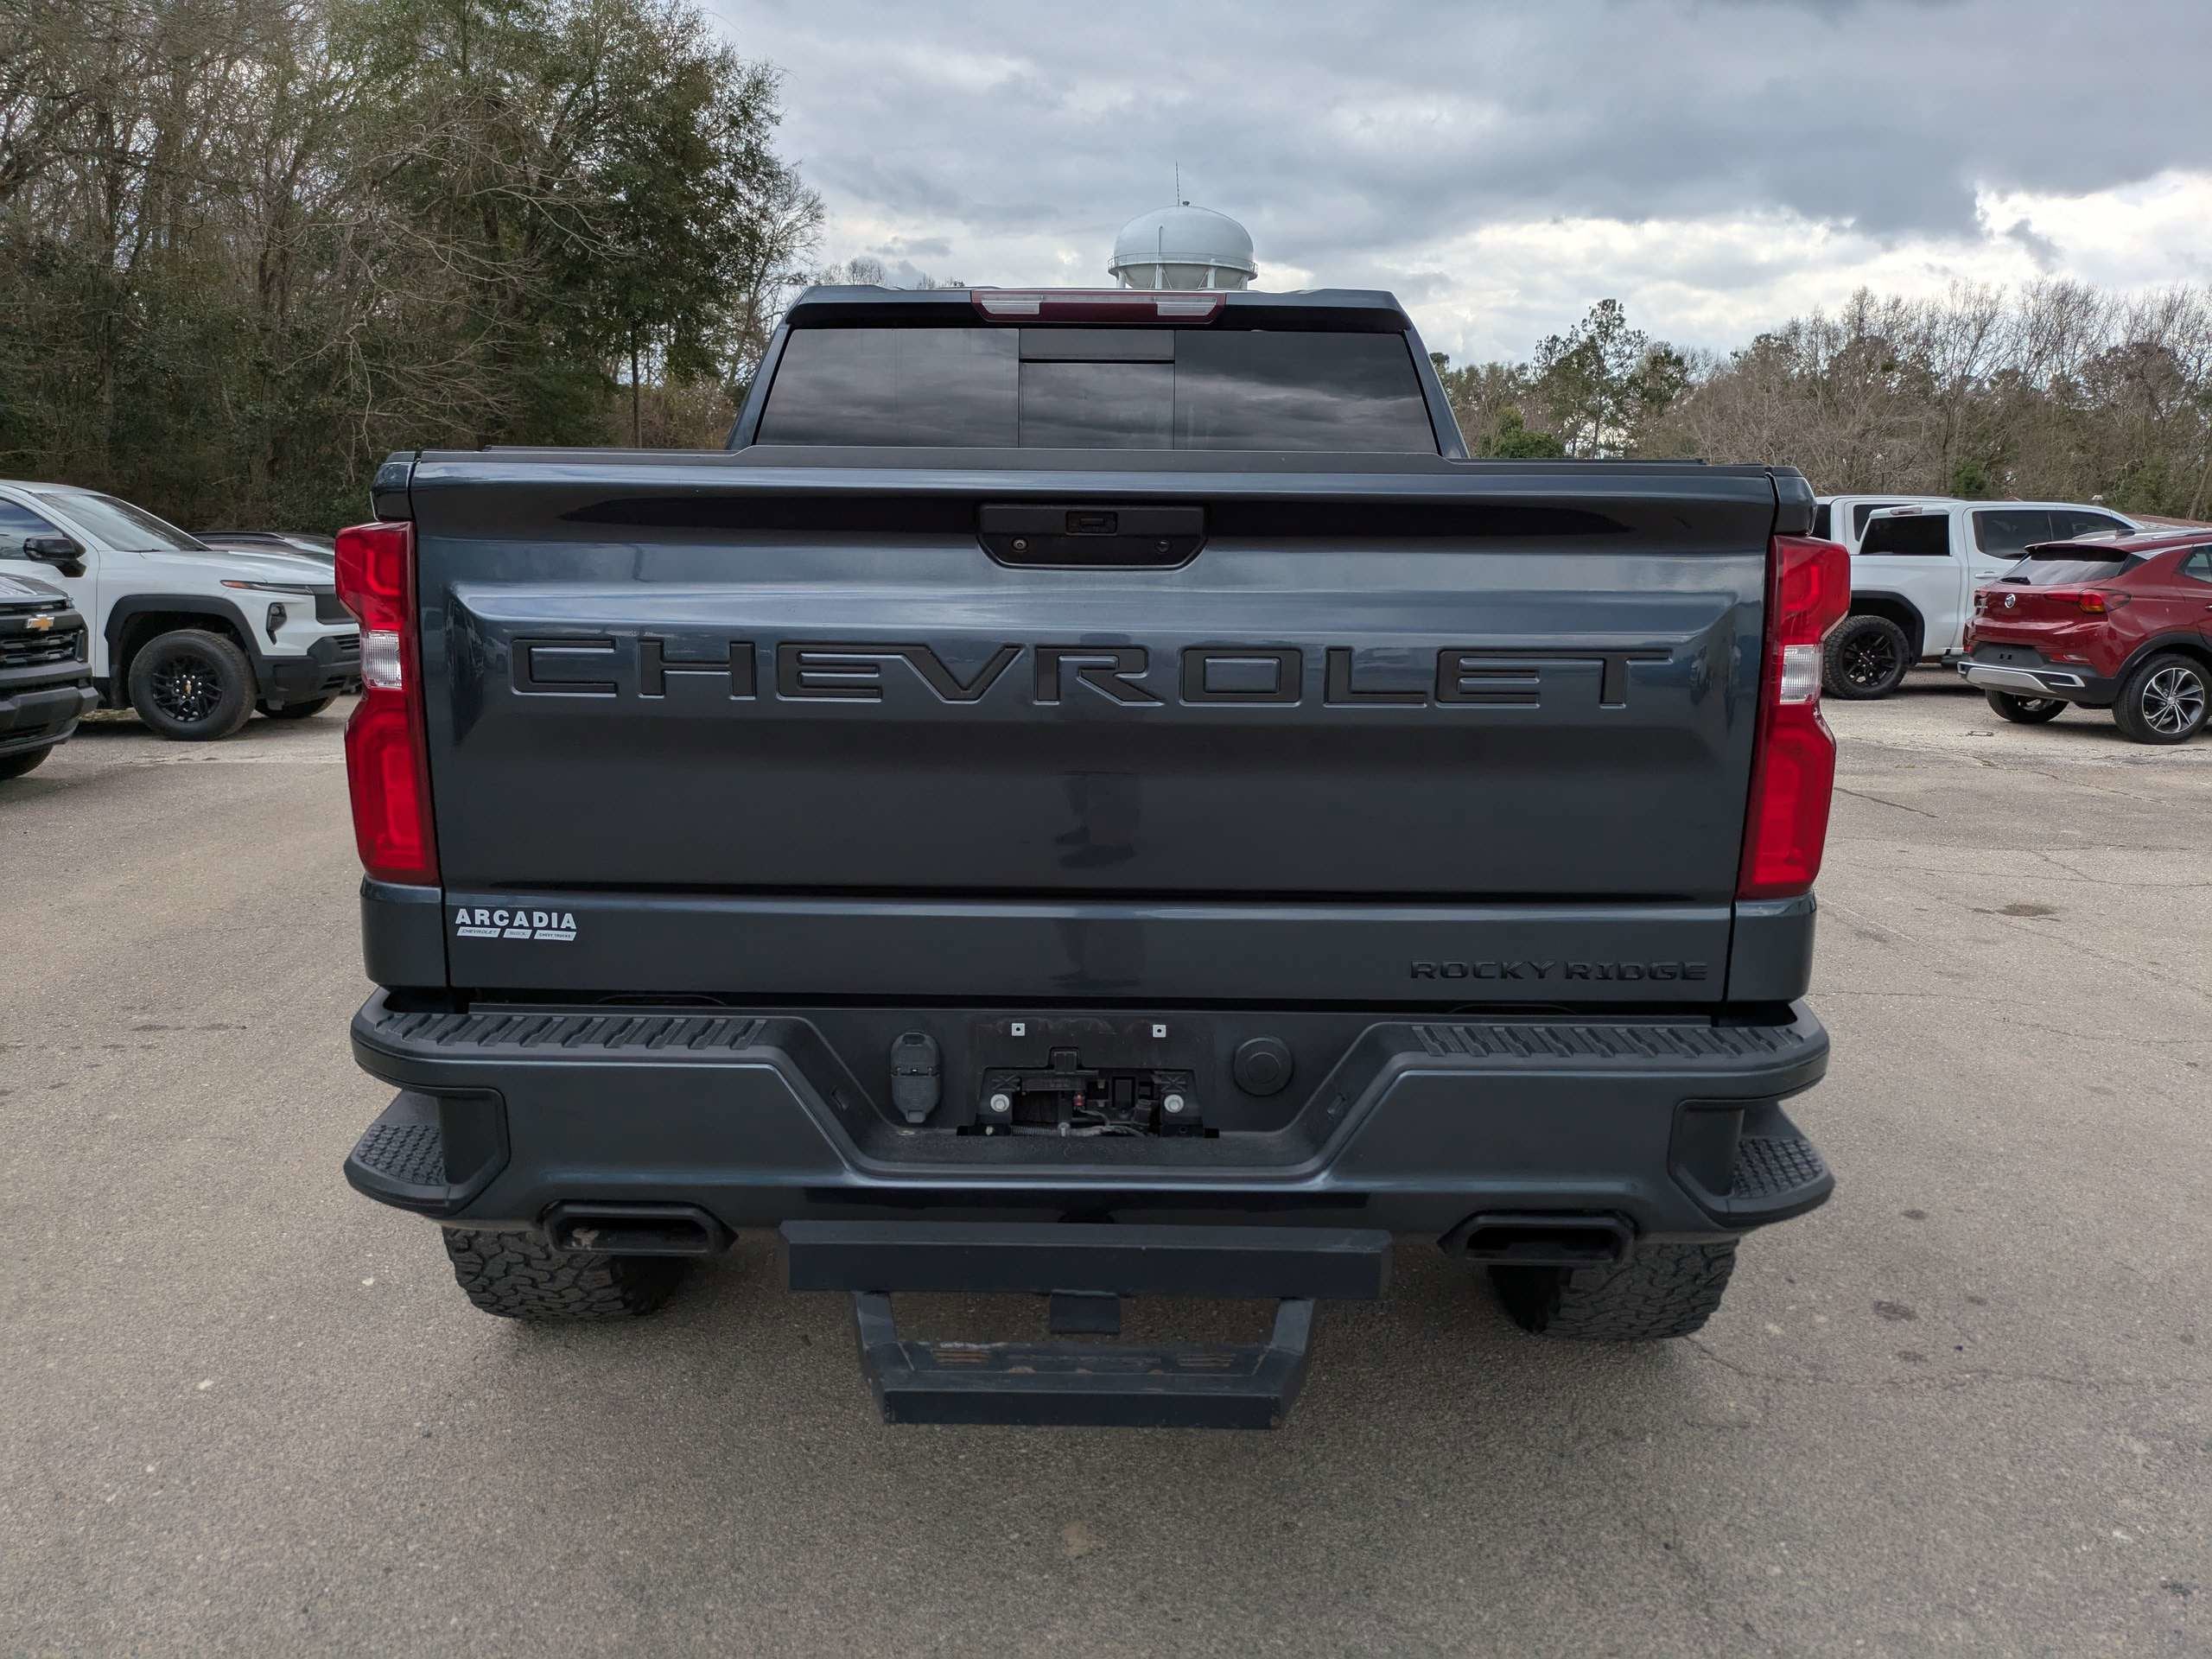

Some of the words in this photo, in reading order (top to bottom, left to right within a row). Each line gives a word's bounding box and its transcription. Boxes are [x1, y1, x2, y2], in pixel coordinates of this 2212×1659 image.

[511, 638, 1675, 709] CHEVROLET
[455, 908, 577, 930] ARCADIA
[1410, 960, 1555, 980] ROCKY
[1564, 961, 1707, 981] RIDGE
